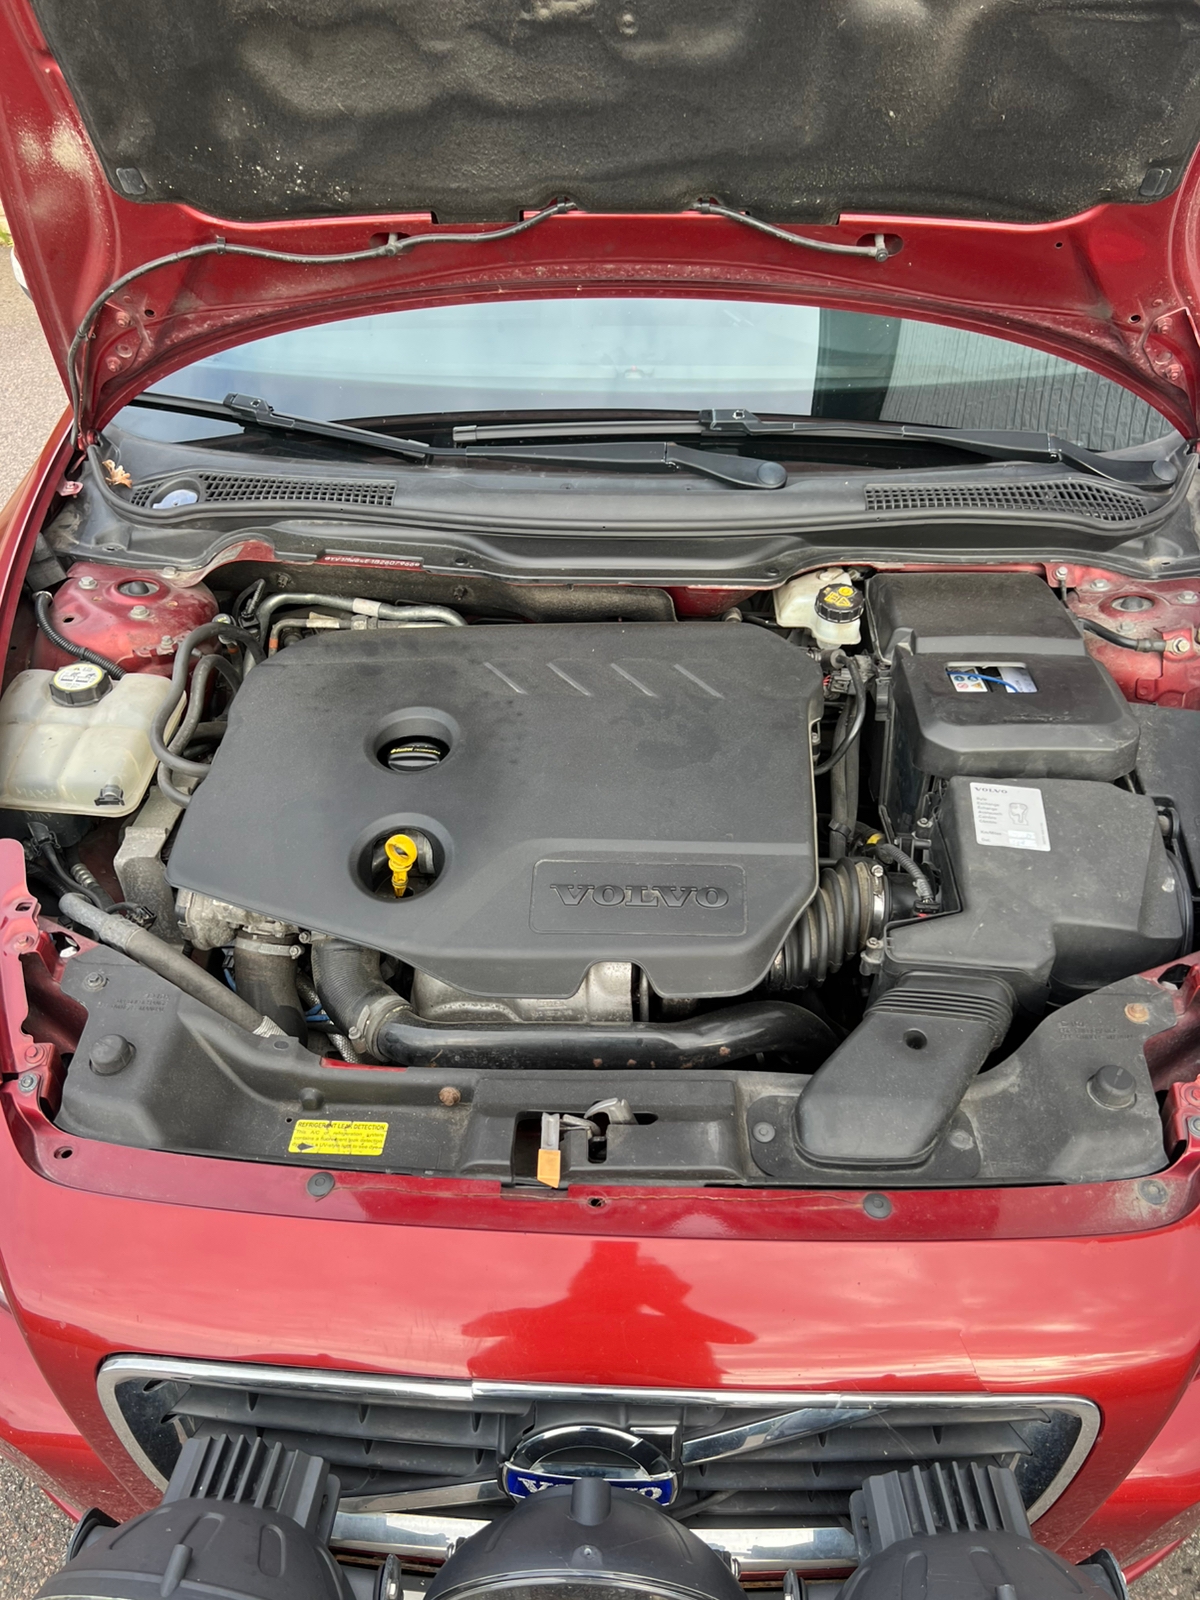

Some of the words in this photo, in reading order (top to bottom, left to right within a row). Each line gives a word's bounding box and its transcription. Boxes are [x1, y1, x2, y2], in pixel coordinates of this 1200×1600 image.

[974, 786, 1008, 794] VOLVO
[550, 884, 730, 909] VOLVO
[298, 1121, 337, 1129] REFRIGERNT
[353, 1123, 386, 1131] DETECTION
